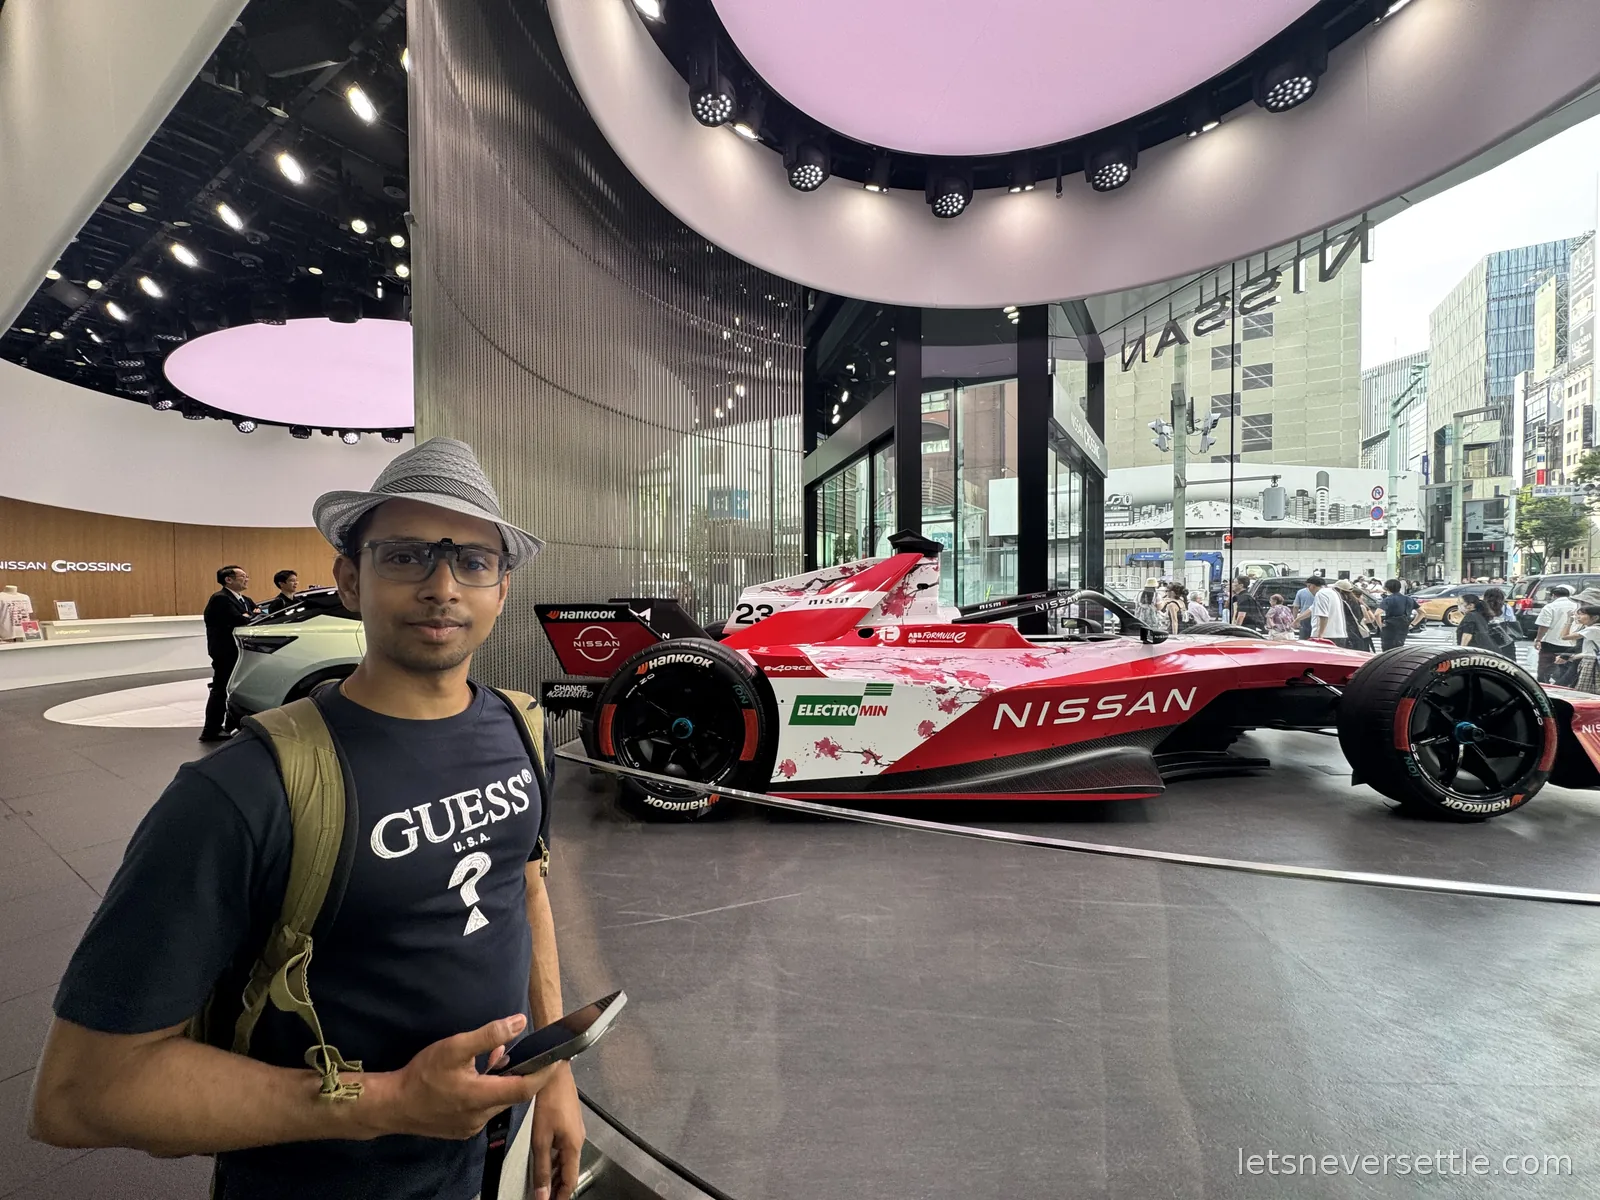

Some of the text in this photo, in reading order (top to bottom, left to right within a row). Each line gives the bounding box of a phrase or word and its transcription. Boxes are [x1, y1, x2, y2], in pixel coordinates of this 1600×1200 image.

[0, 560, 132, 572] NISSAN CROSSING
[1034, 591, 1080, 612] NISSAN
[736, 603, 774, 625] 23
[553, 684, 588, 692] CHANGE
[797, 703, 888, 717] ELECTROMIN
[993, 687, 1197, 730] NISSAN
